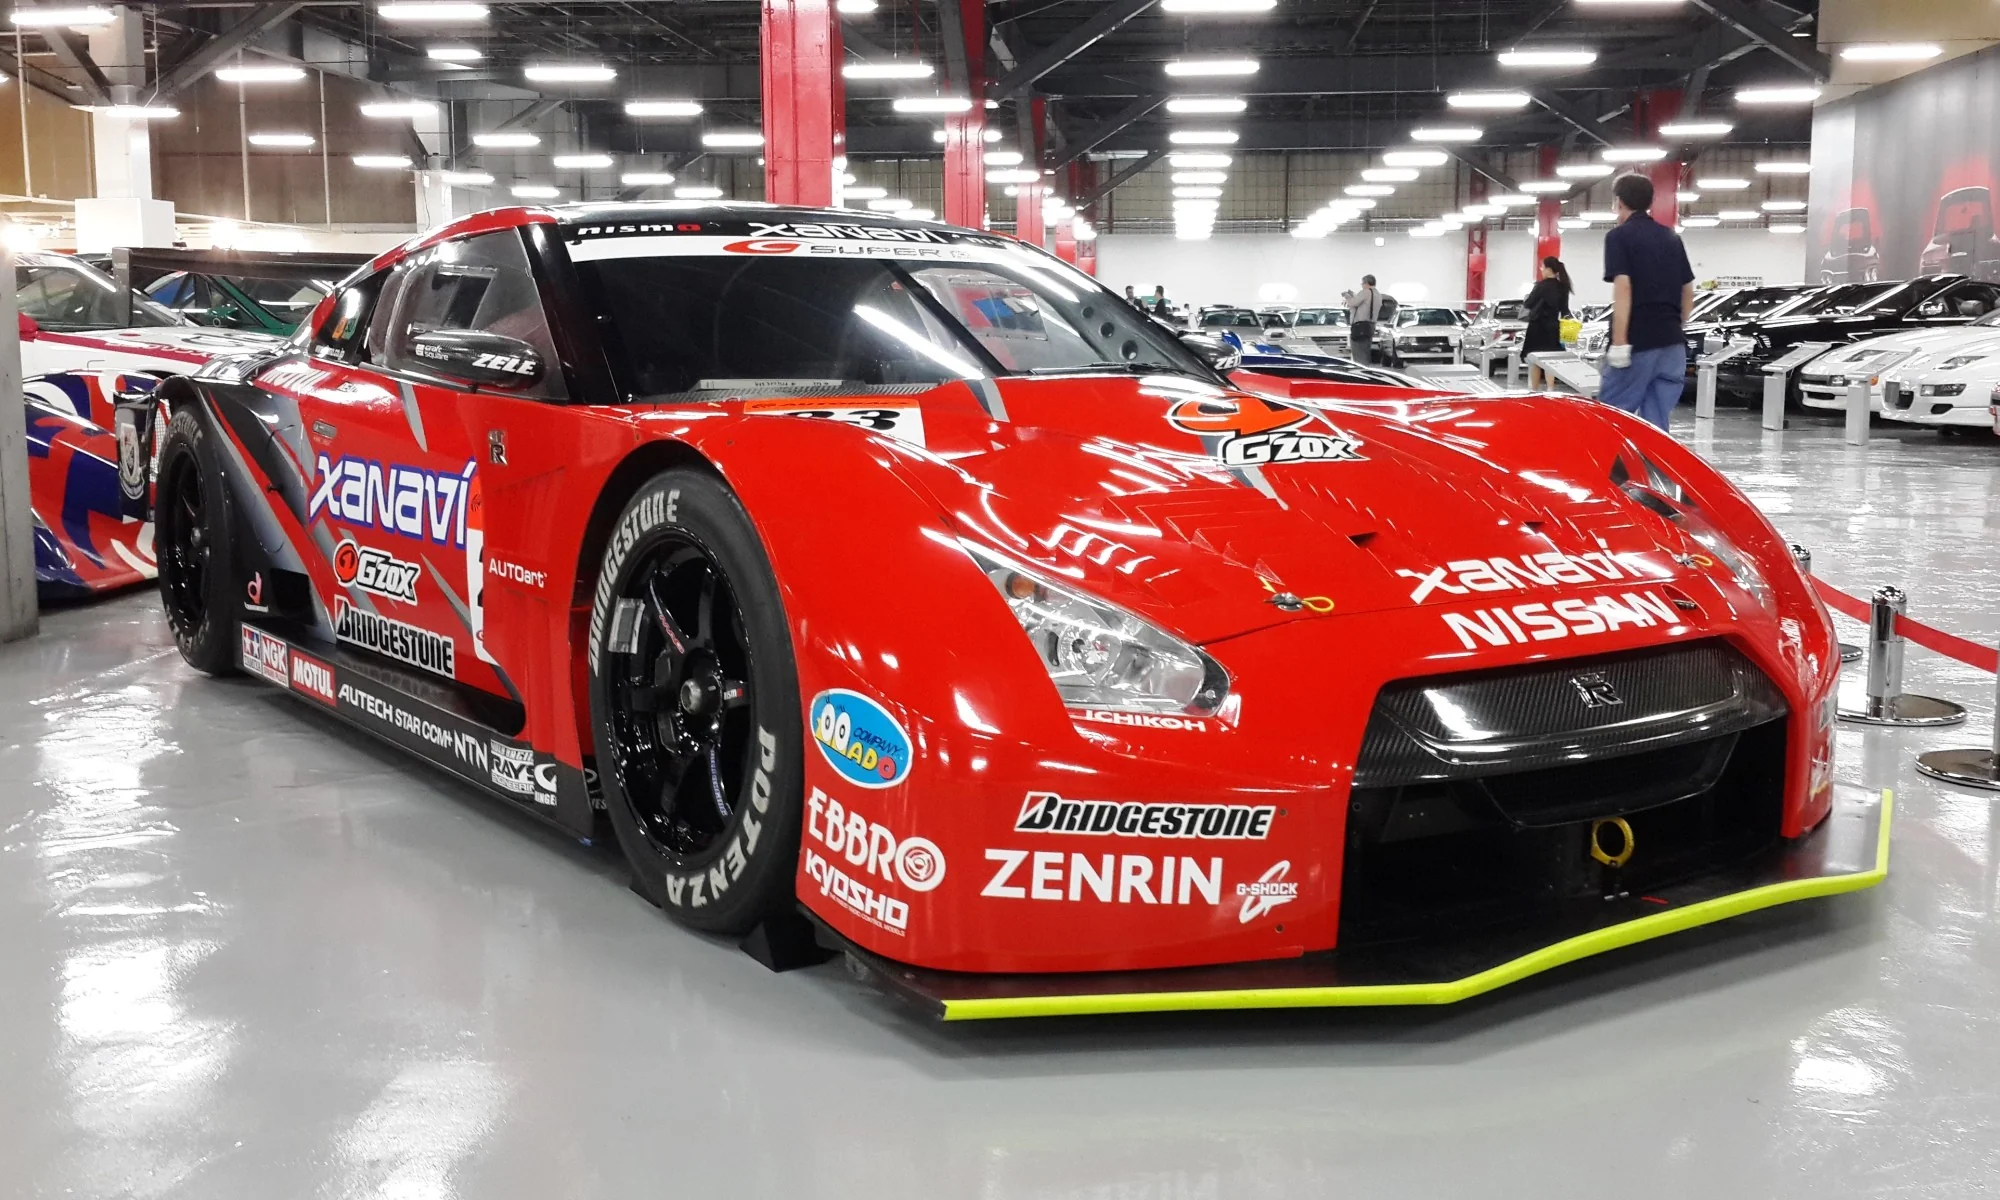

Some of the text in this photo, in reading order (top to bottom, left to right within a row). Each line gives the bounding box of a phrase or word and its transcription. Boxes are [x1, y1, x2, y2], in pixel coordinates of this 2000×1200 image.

[578, 223, 701, 236] nismo
[810, 244, 942, 259] SUPER
[471, 353, 537, 376] ZELE
[488, 558, 548, 589] AUTOart
[335, 595, 455, 676] BRIDGESTONE
[1440, 590, 1681, 650] NISSAN
[261, 636, 287, 673] NGK
[293, 656, 334, 700] MOTUL
[337, 682, 394, 724] AUTECH
[394, 708, 422, 737] STAR
[1084, 709, 1207, 732] ICHIKOH
[453, 729, 489, 773] NTN
[665, 724, 777, 908] POTENZA
[1018, 792, 1273, 837] BRIDGESTONE
[807, 784, 947, 893] EBBRO
[980, 849, 1223, 905] ZENRIN
[1236, 882, 1298, 896] G-SHOCK
